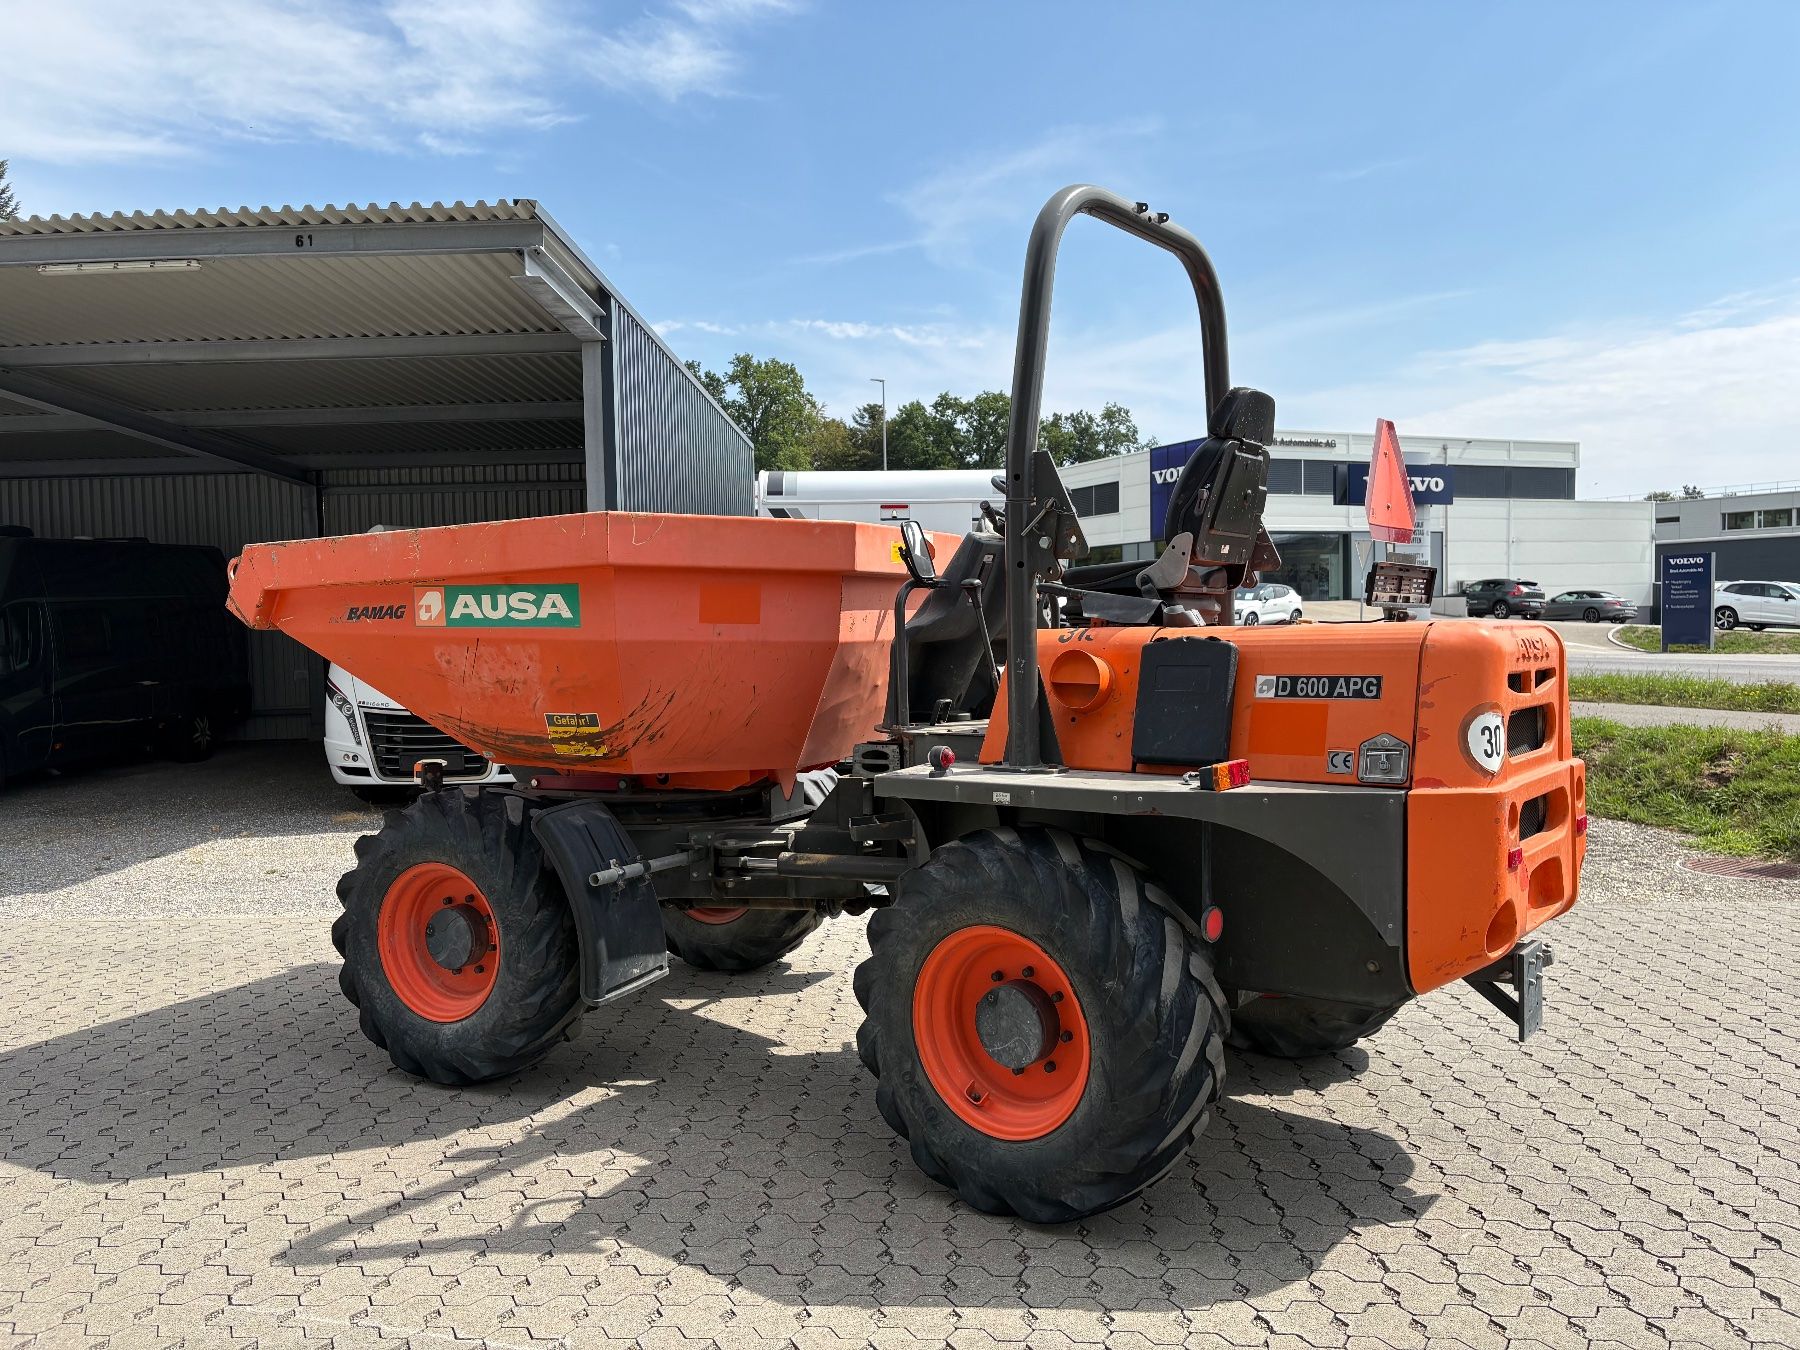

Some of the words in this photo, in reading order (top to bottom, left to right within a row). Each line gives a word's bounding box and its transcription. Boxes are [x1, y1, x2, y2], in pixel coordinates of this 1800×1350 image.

[295, 234, 313, 248] 61
[1668, 557, 1704, 565] VOLVO
[346, 604, 407, 621] BAMAG
[450, 592, 574, 620] AUSA
[1277, 677, 1291, 696] D
[1296, 677, 1329, 697] 600
[1333, 677, 1378, 698] APG
[1480, 724, 1501, 759] 30
[1330, 752, 1351, 769] CE
